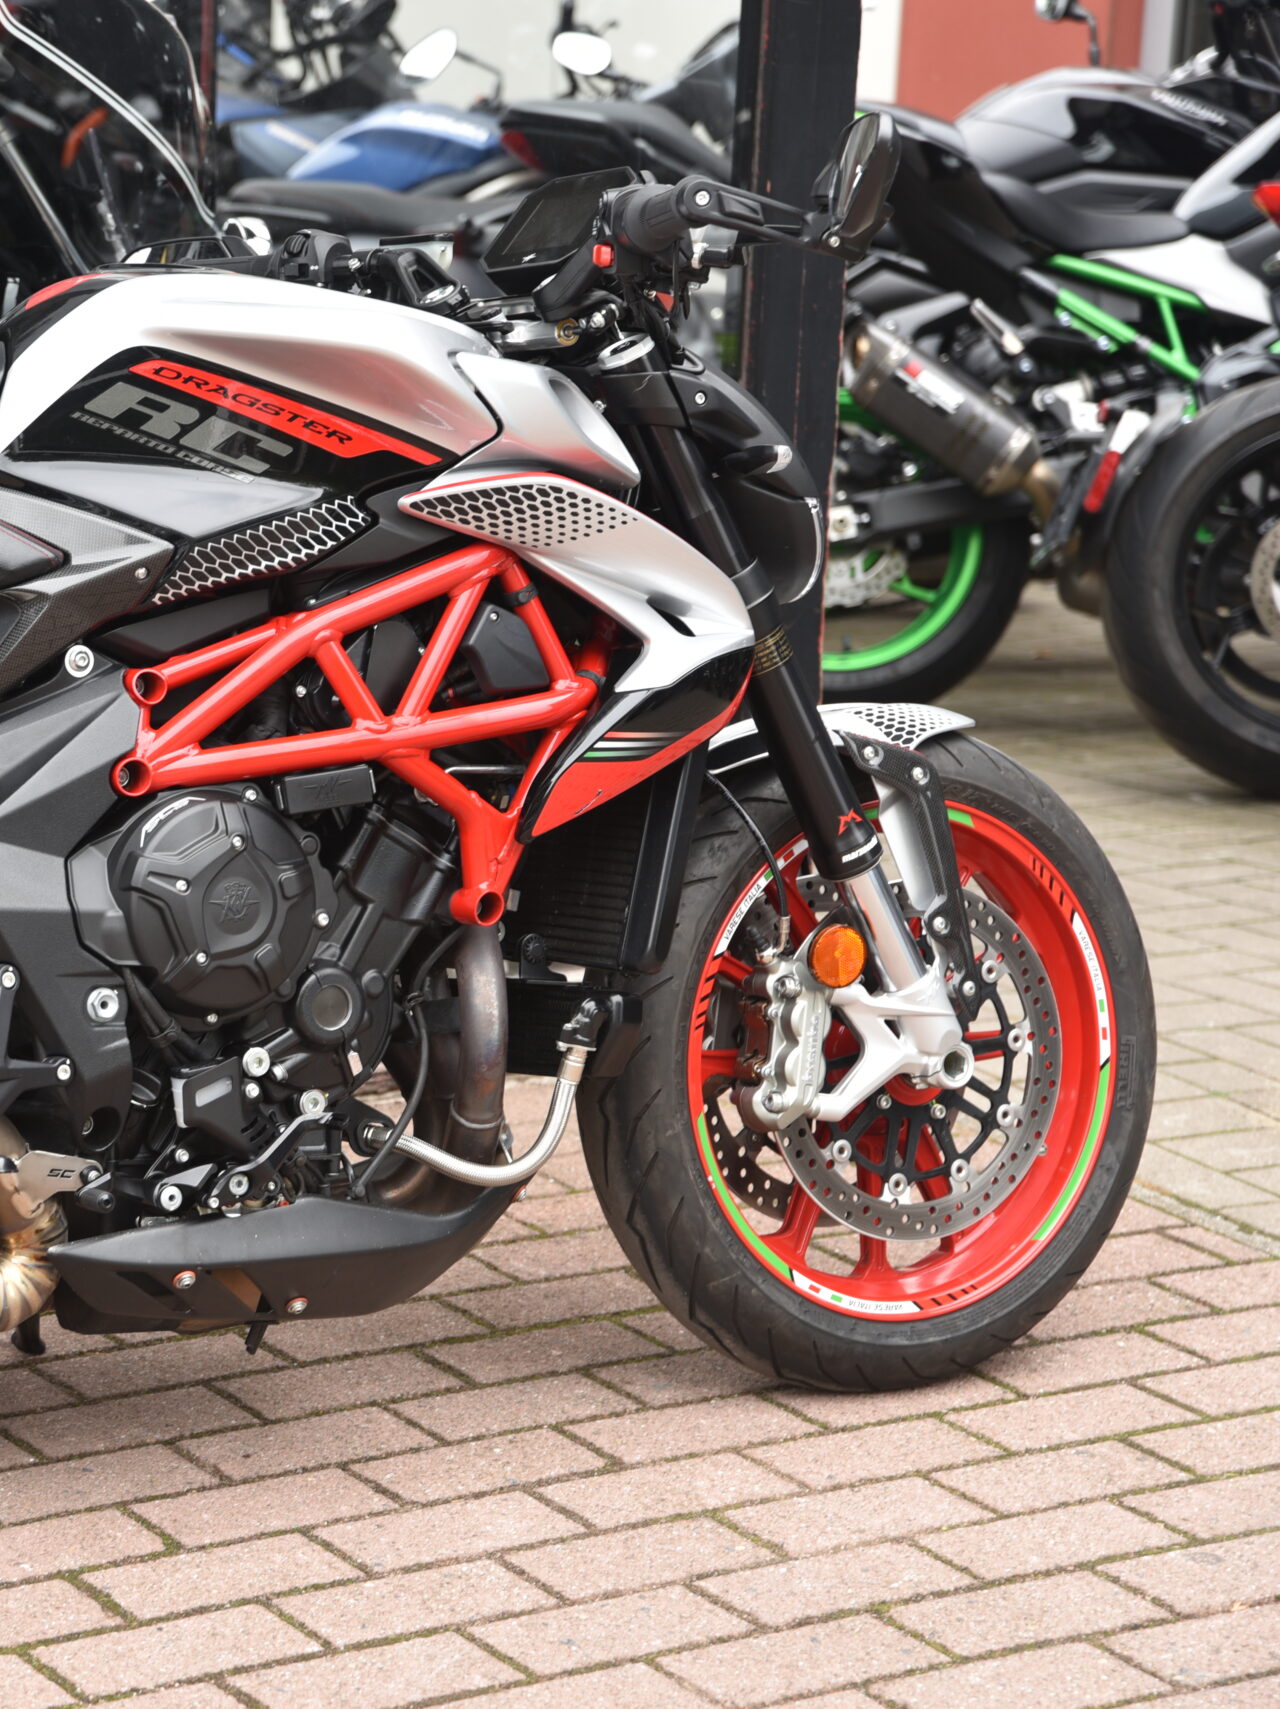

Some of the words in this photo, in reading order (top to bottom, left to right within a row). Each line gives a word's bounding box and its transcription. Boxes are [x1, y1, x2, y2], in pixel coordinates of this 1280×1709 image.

[83, 381, 295, 475] RC
[151, 365, 355, 446] DRAGSTER
[69, 410, 177, 455] REPARTO
[179, 449, 256, 484] CORSE
[723, 907, 744, 940] VARESE
[743, 883, 762, 909] ITALIA
[1077, 929, 1096, 963] VARESE
[1092, 964, 1103, 992] ITALIA
[47, 1168, 76, 1179] SC
